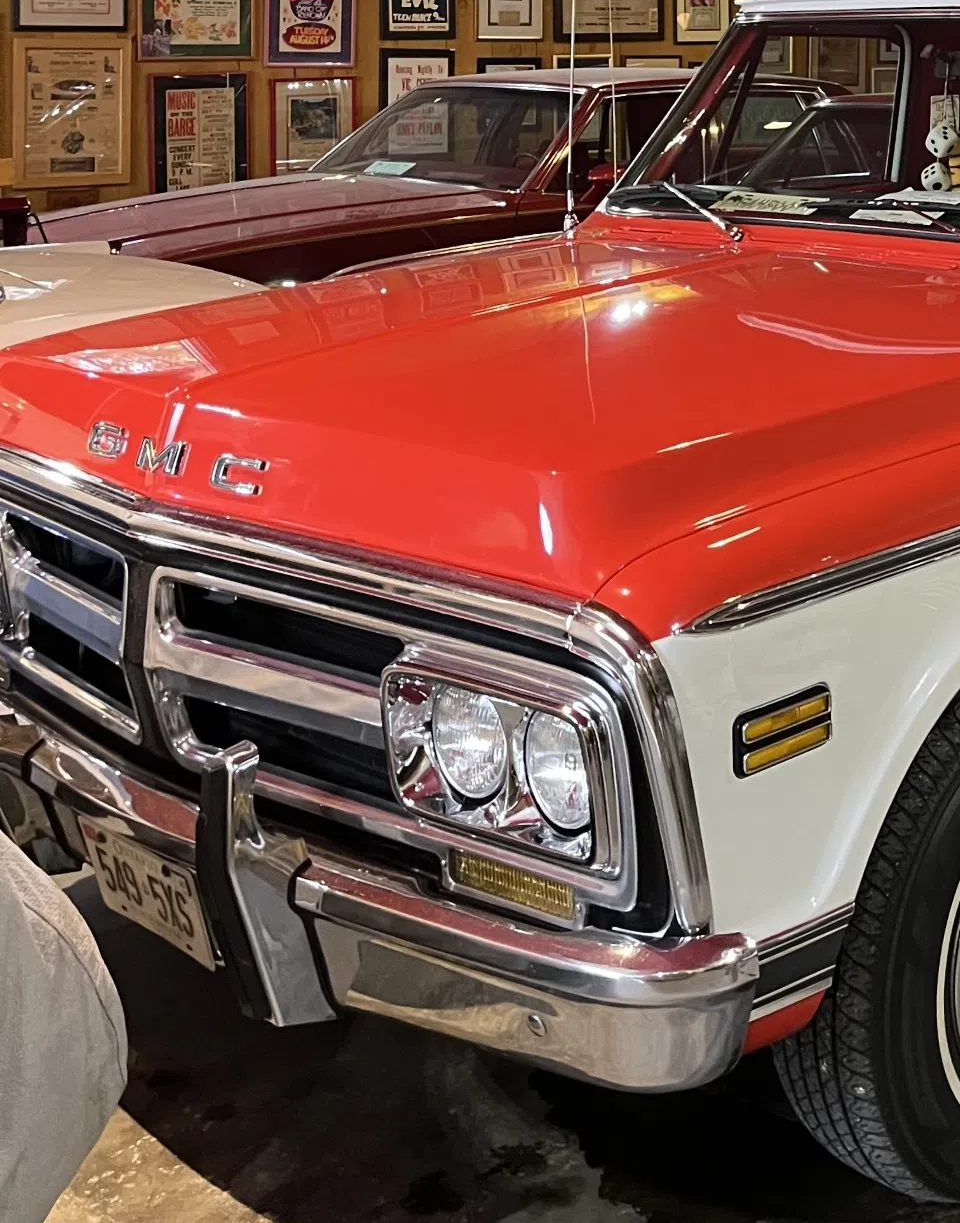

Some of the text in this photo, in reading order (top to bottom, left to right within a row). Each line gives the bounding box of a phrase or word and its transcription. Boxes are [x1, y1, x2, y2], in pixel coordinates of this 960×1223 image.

[293, 27, 329, 35] TUESDAY
[289, 35, 320, 45] AUGUST
[167, 91, 196, 111] MUSIC
[168, 117, 196, 138] BARGE
[169, 144, 196, 153] CONCERT
[172, 153, 192, 161] EVERY
[88, 421, 270, 496] GMC
